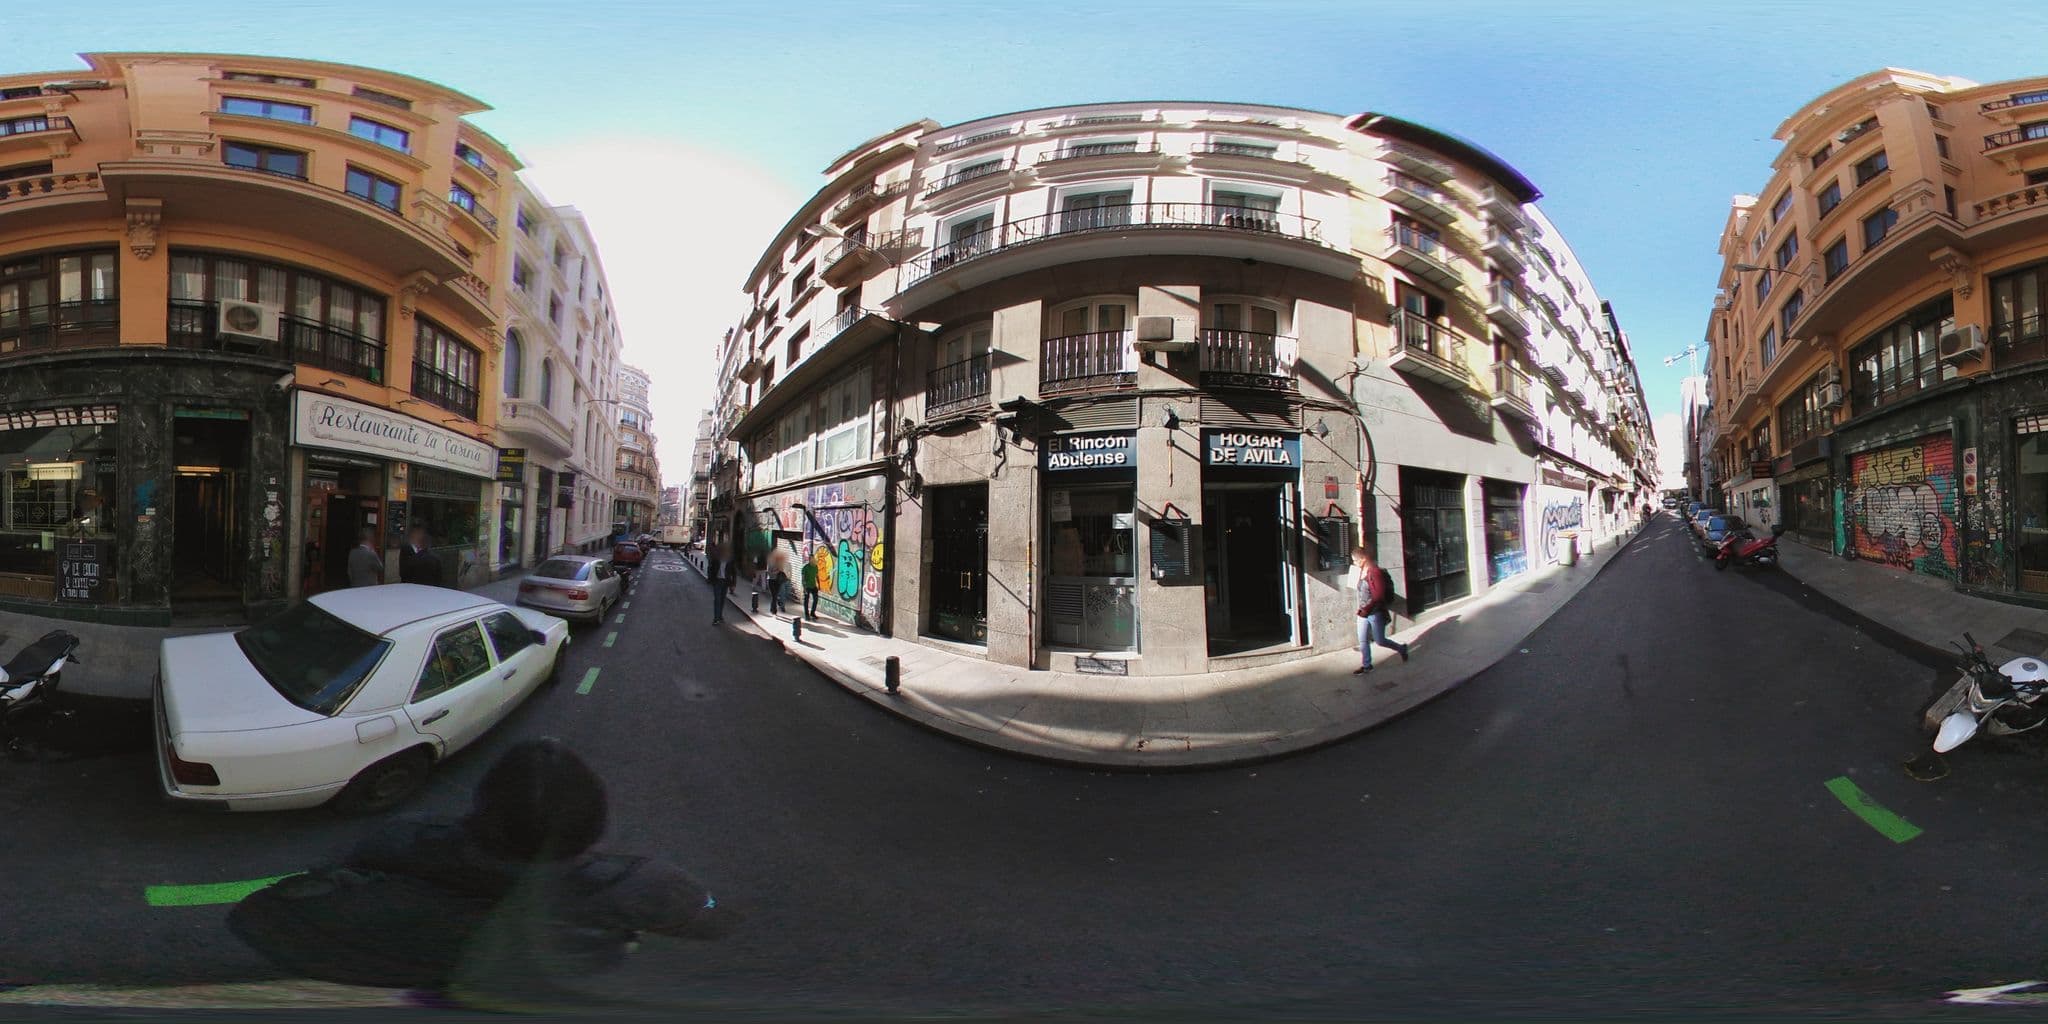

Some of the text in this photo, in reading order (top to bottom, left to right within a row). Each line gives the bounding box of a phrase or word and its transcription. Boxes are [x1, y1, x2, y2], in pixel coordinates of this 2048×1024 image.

[319, 405, 419, 445] Restaurante
[1048, 434, 1127, 452] El Rincón
[1220, 432, 1283, 449] HOGAR
[1048, 451, 1126, 468] Abulense
[1212, 447, 1291, 465] DE AVILA
